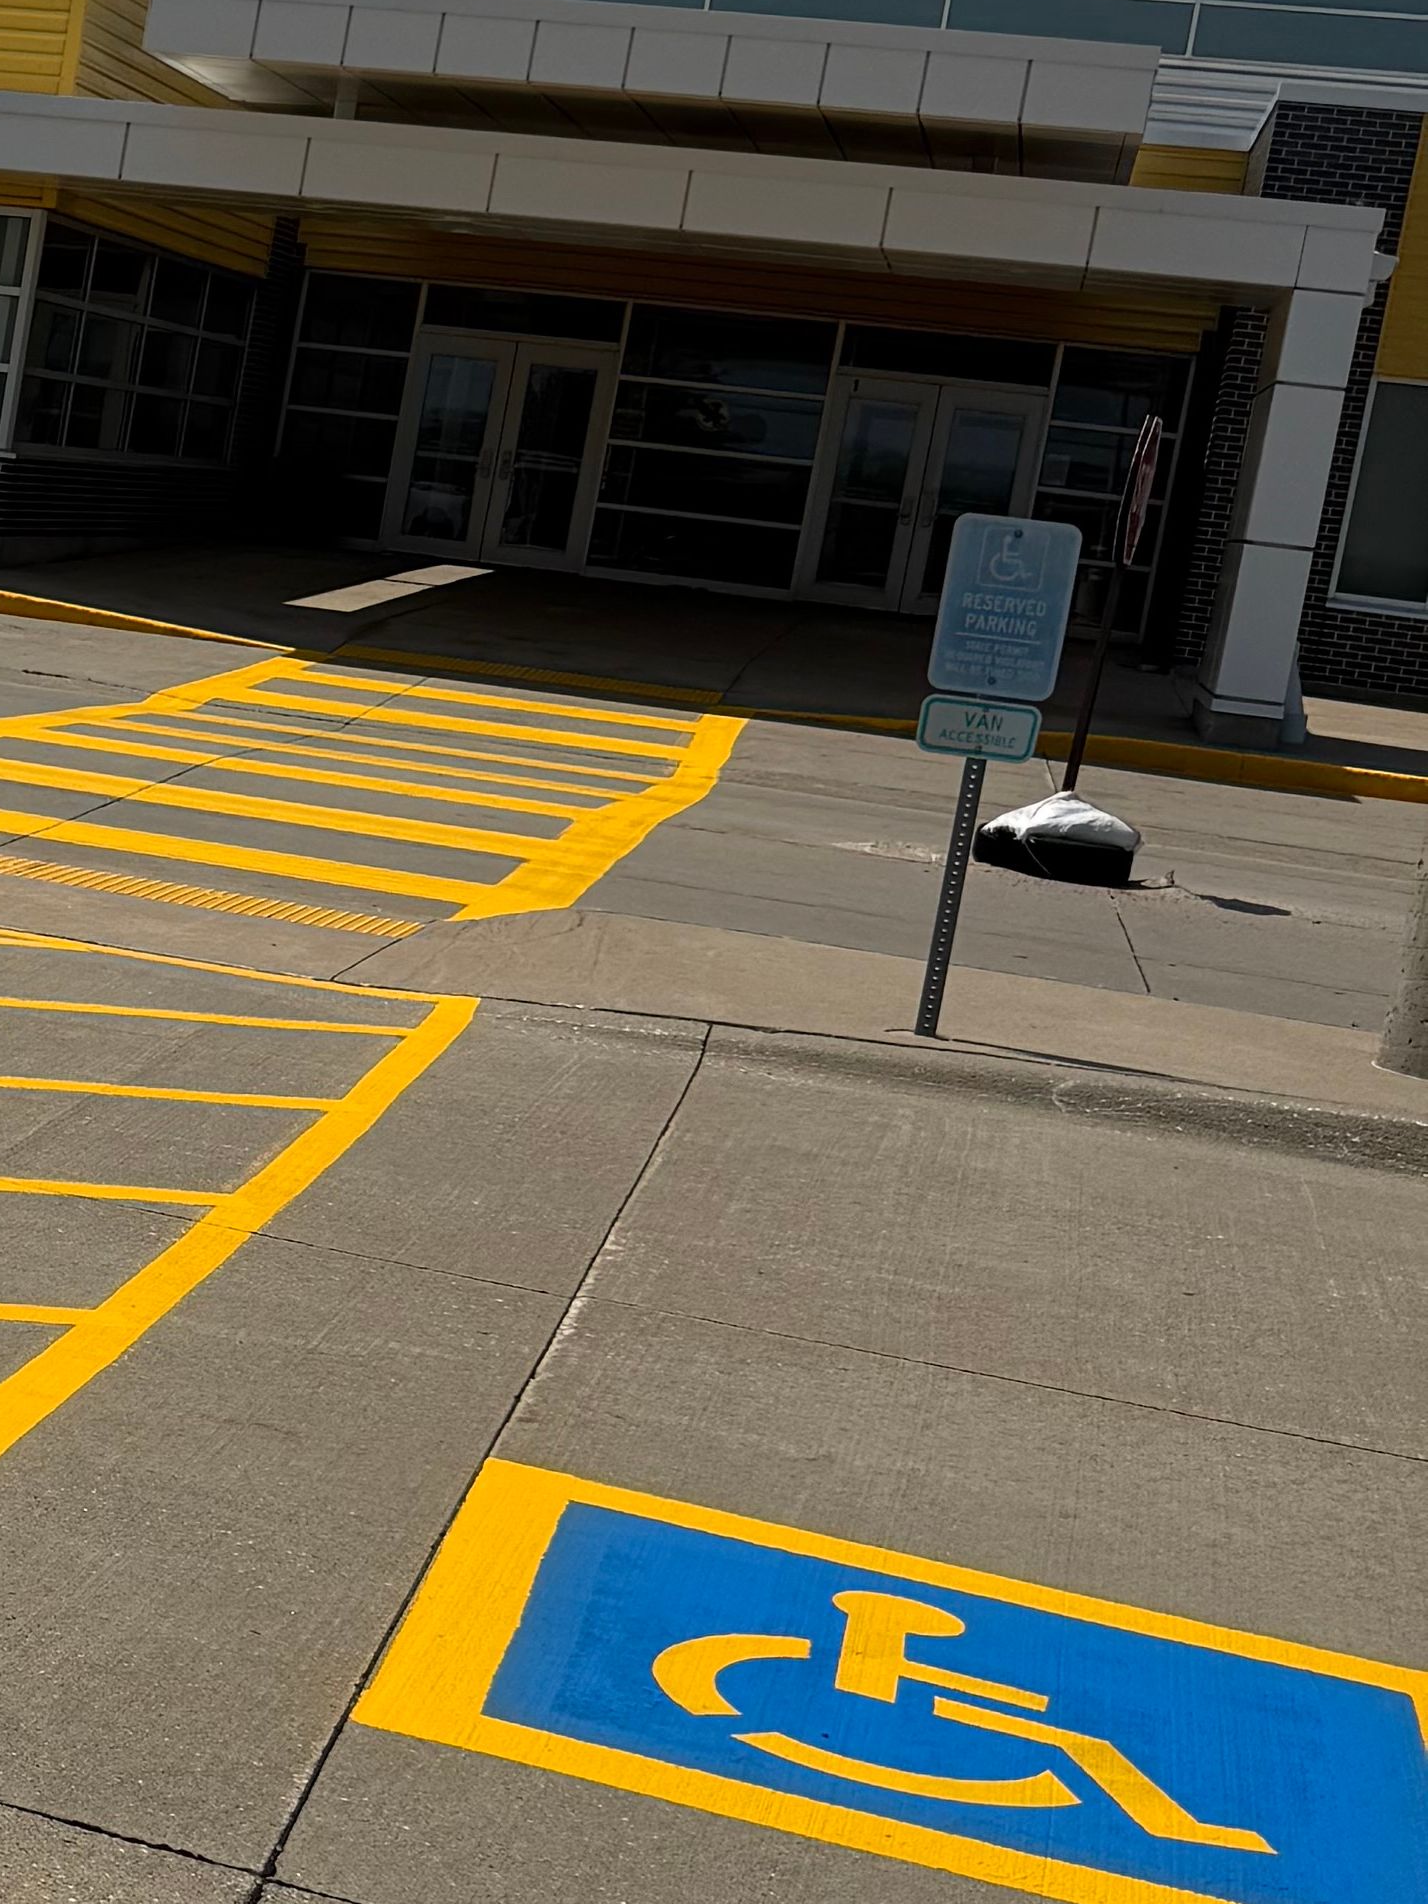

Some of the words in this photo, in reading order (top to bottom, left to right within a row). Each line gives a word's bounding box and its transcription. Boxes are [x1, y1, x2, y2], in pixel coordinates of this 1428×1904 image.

[962, 592, 1047, 617] RESERVED
[965, 613, 1037, 638] PARKING
[964, 711, 1004, 732] VAN
[938, 728, 1017, 749] ACCESSIBLE
